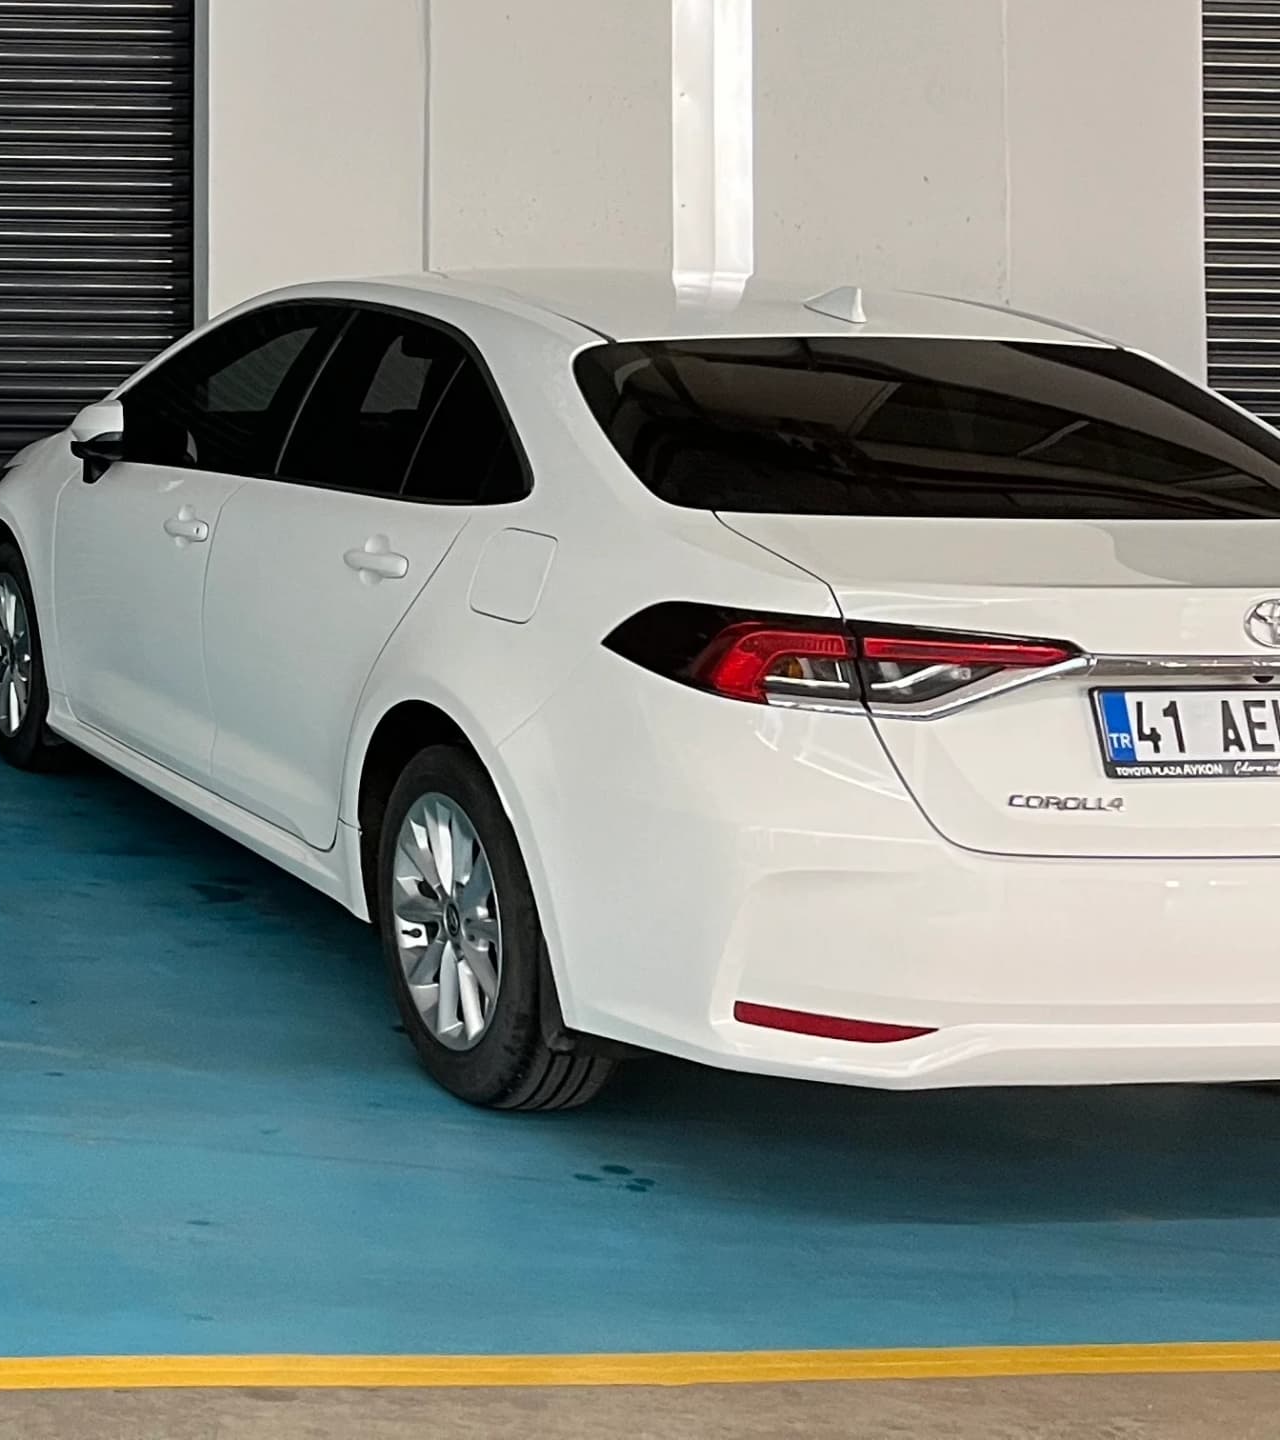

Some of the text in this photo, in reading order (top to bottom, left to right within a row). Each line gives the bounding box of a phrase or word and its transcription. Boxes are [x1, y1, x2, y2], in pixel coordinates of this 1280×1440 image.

[1135, 700, 1186, 754] 41
[1109, 732, 1133, 749] TR
[1115, 766, 1152, 776] TOYOTA
[1152, 766, 1183, 776] PLAZA
[1007, 794, 1124, 811] COROLLA
